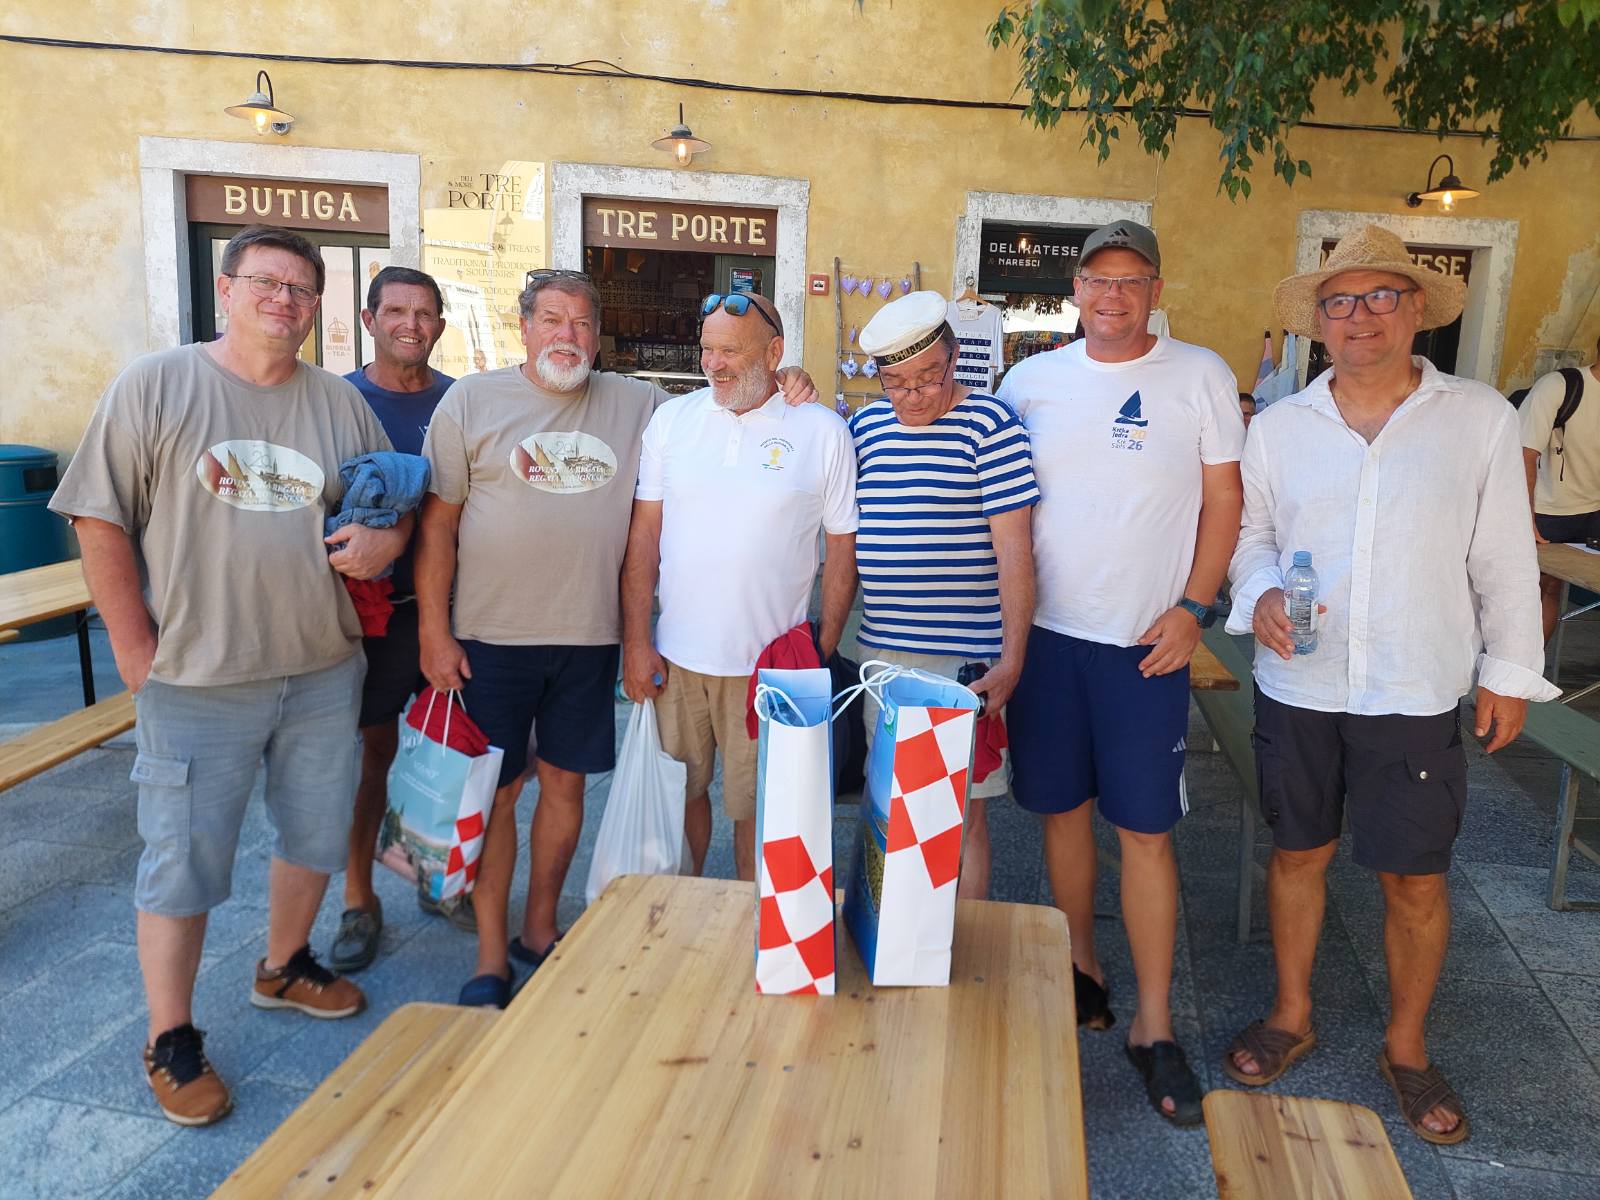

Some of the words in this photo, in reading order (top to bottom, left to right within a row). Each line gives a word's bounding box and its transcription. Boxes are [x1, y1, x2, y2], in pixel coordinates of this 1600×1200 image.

[480, 173, 522, 193] TRE
[223, 184, 361, 222] BUTIGA
[448, 190, 522, 213] PORTE
[596, 208, 658, 240] TRE
[671, 213, 767, 246] PORTE
[508, 244, 541, 253] TREATS
[989, 241, 1079, 257] DELIKATESE
[433, 256, 488, 268] TRADITIONAL
[492, 261, 540, 271] PRODUCTS
[998, 257, 1041, 267] NARESCI
[466, 268, 515, 278] SOUVENIRS
[325, 344, 351, 352] BUBBLE
[1127, 439, 1144, 451] 26
